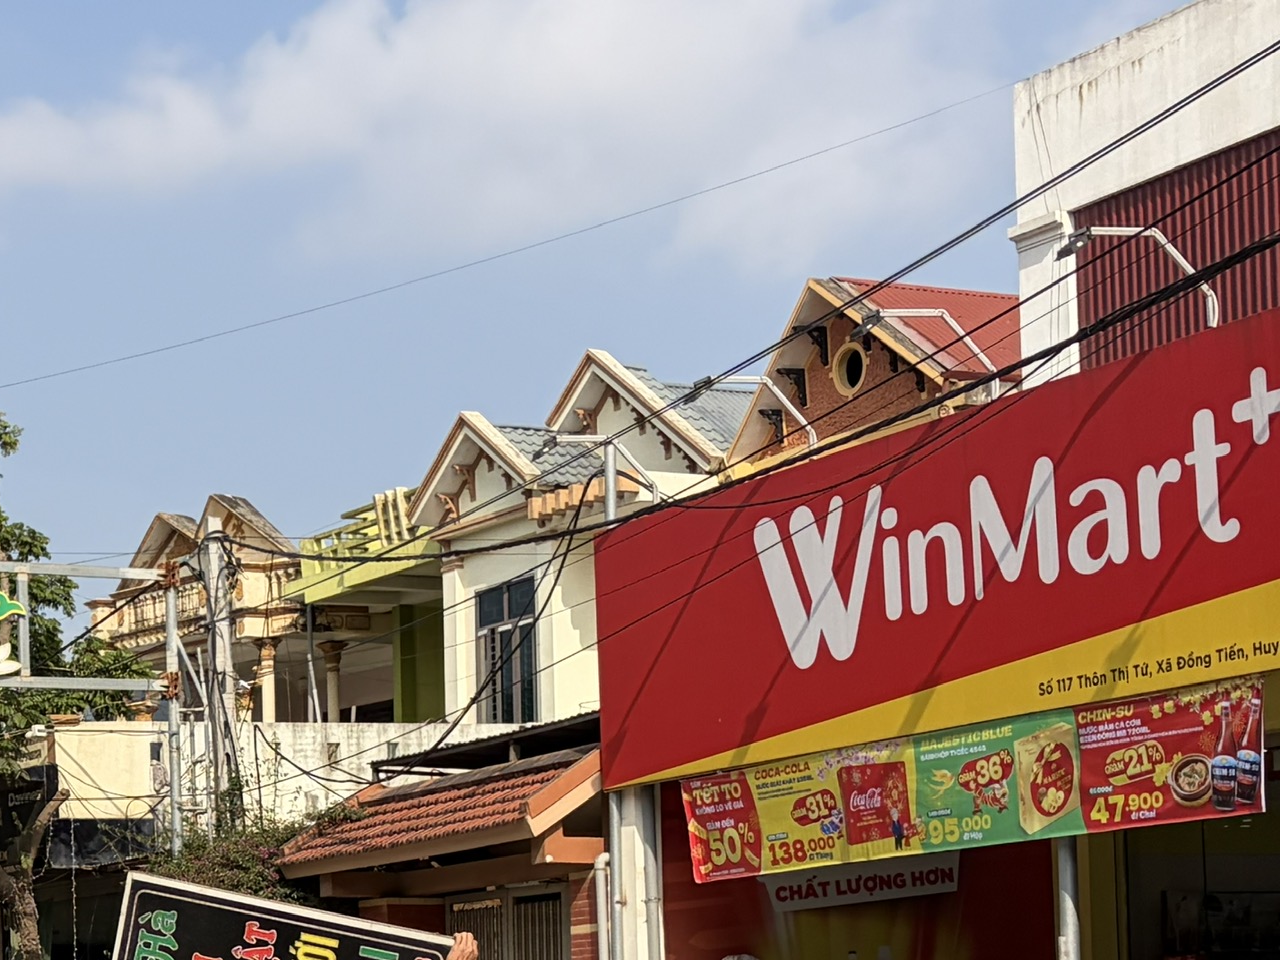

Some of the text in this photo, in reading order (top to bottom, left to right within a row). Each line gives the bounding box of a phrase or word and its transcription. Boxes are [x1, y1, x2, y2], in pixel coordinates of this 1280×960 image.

[1038, 640, 1280, 696] Số 117 Thôn Thị Tứ, Xã Đồng Tiến, Huy
[1078, 704, 1134, 724] CHIN-SU
[981, 725, 1013, 740] BLUE
[754, 761, 810, 780] COCA-COLA
[976, 750, 1012, 784] 36%
[1124, 745, 1162, 776] 21%
[721, 782, 742, 800] TO
[806, 793, 835, 819] 31%
[1090, 791, 1163, 824] 47.900
[708, 822, 755, 866] 50%
[928, 814, 992, 845] 95.000
[768, 836, 835, 867] 138.000
[775, 867, 955, 903] CHẤT LƯỢNG HƠN
